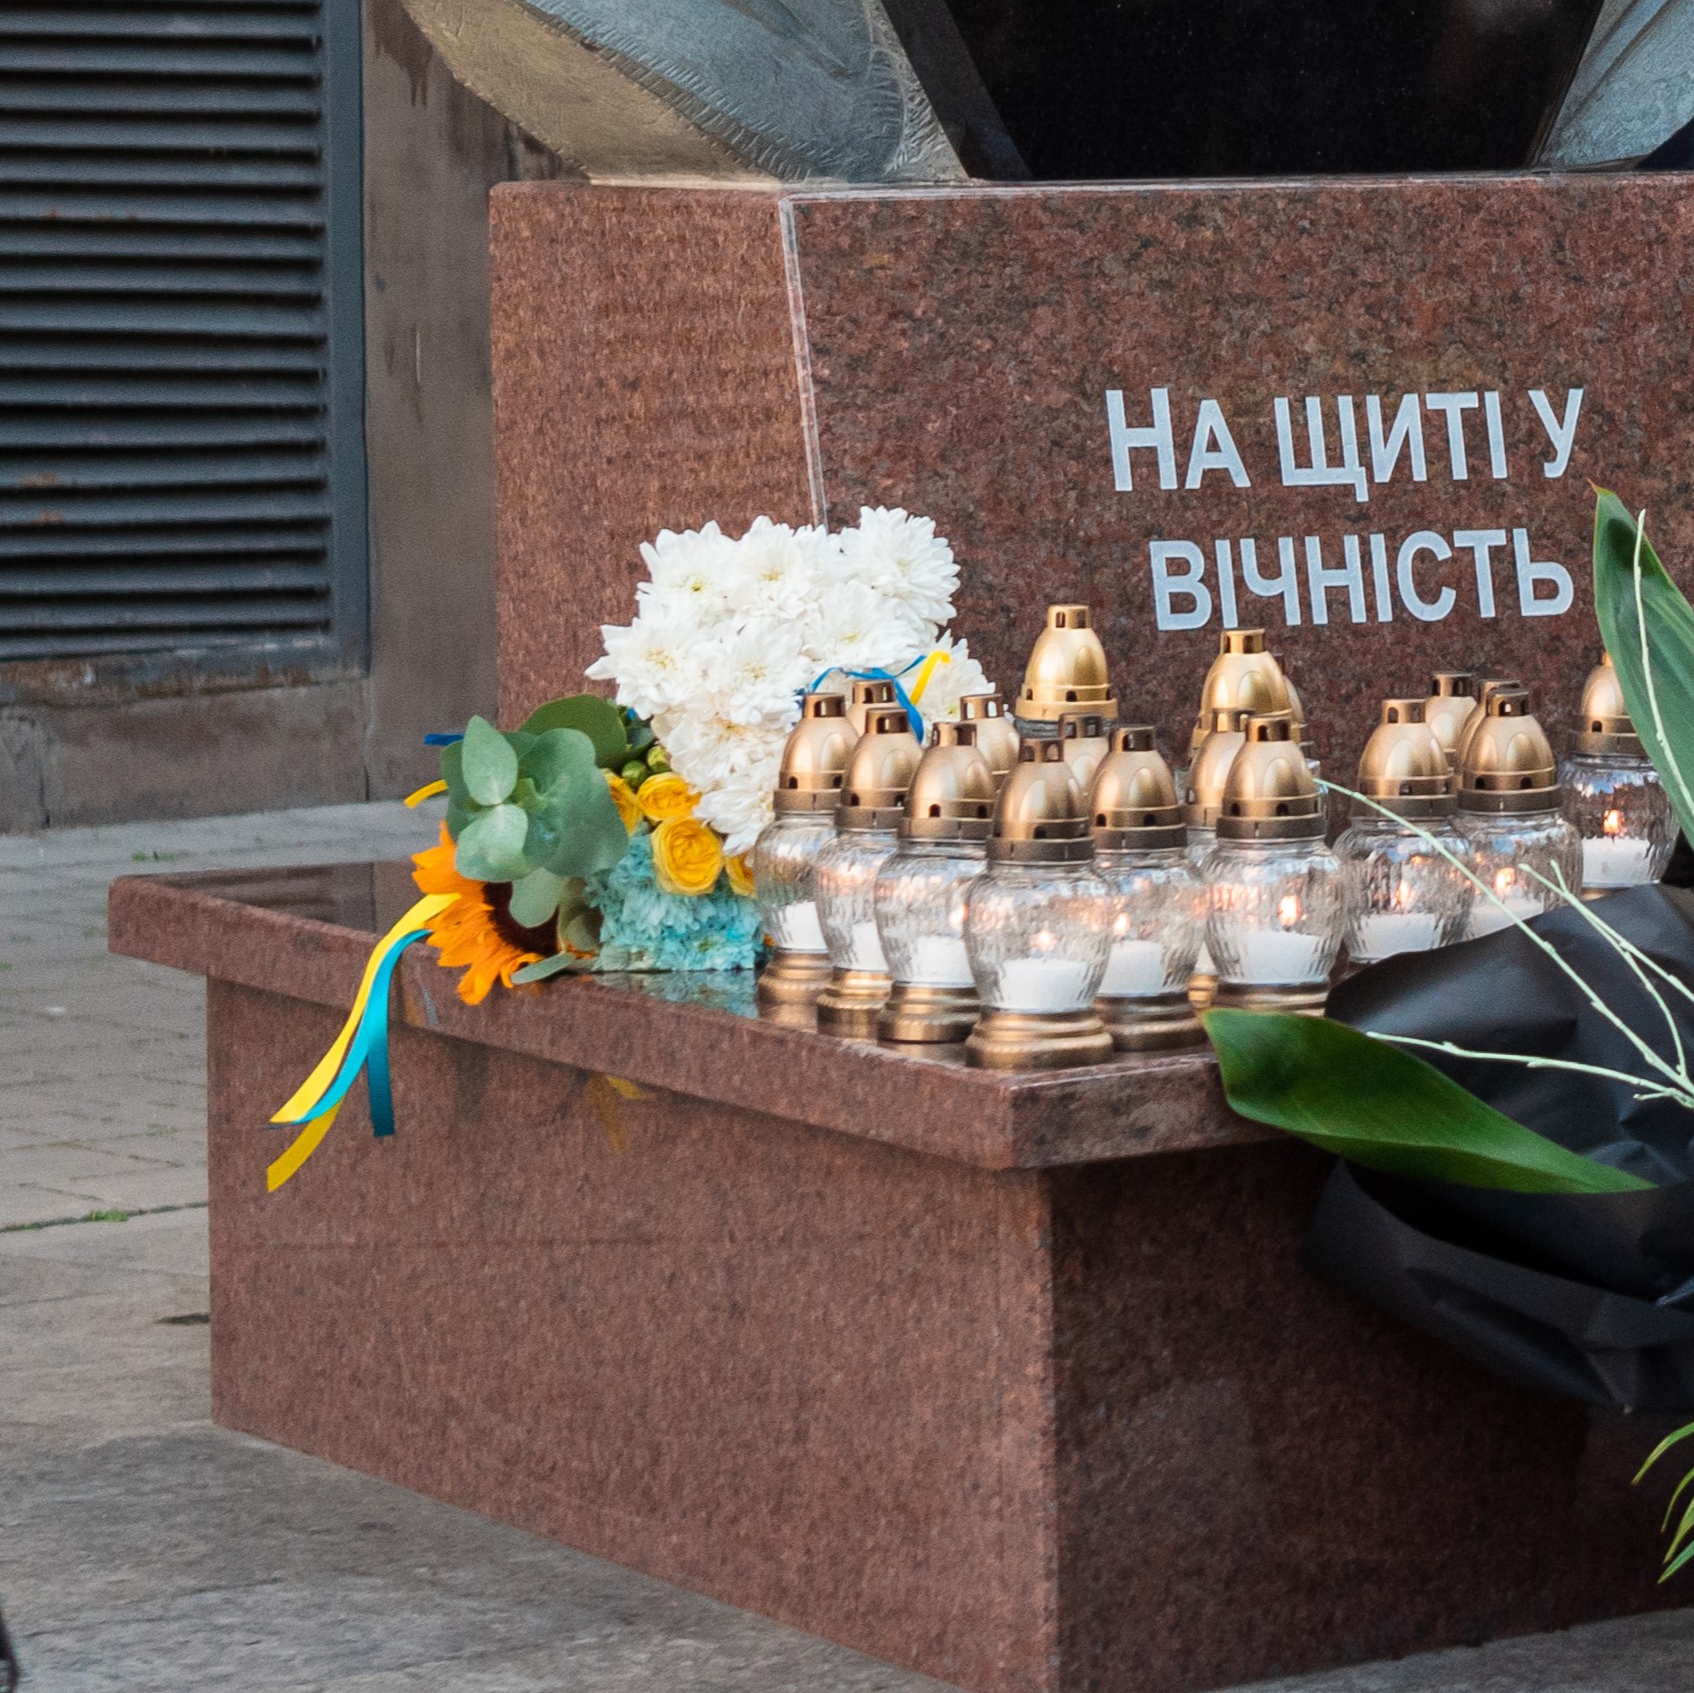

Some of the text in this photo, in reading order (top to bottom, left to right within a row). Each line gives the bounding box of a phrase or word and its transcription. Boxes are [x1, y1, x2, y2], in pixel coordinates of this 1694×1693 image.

[1105, 387, 1584, 503] НА ЩИТІ У
[1148, 527, 1574, 632] ВІЧНІСТЬ
